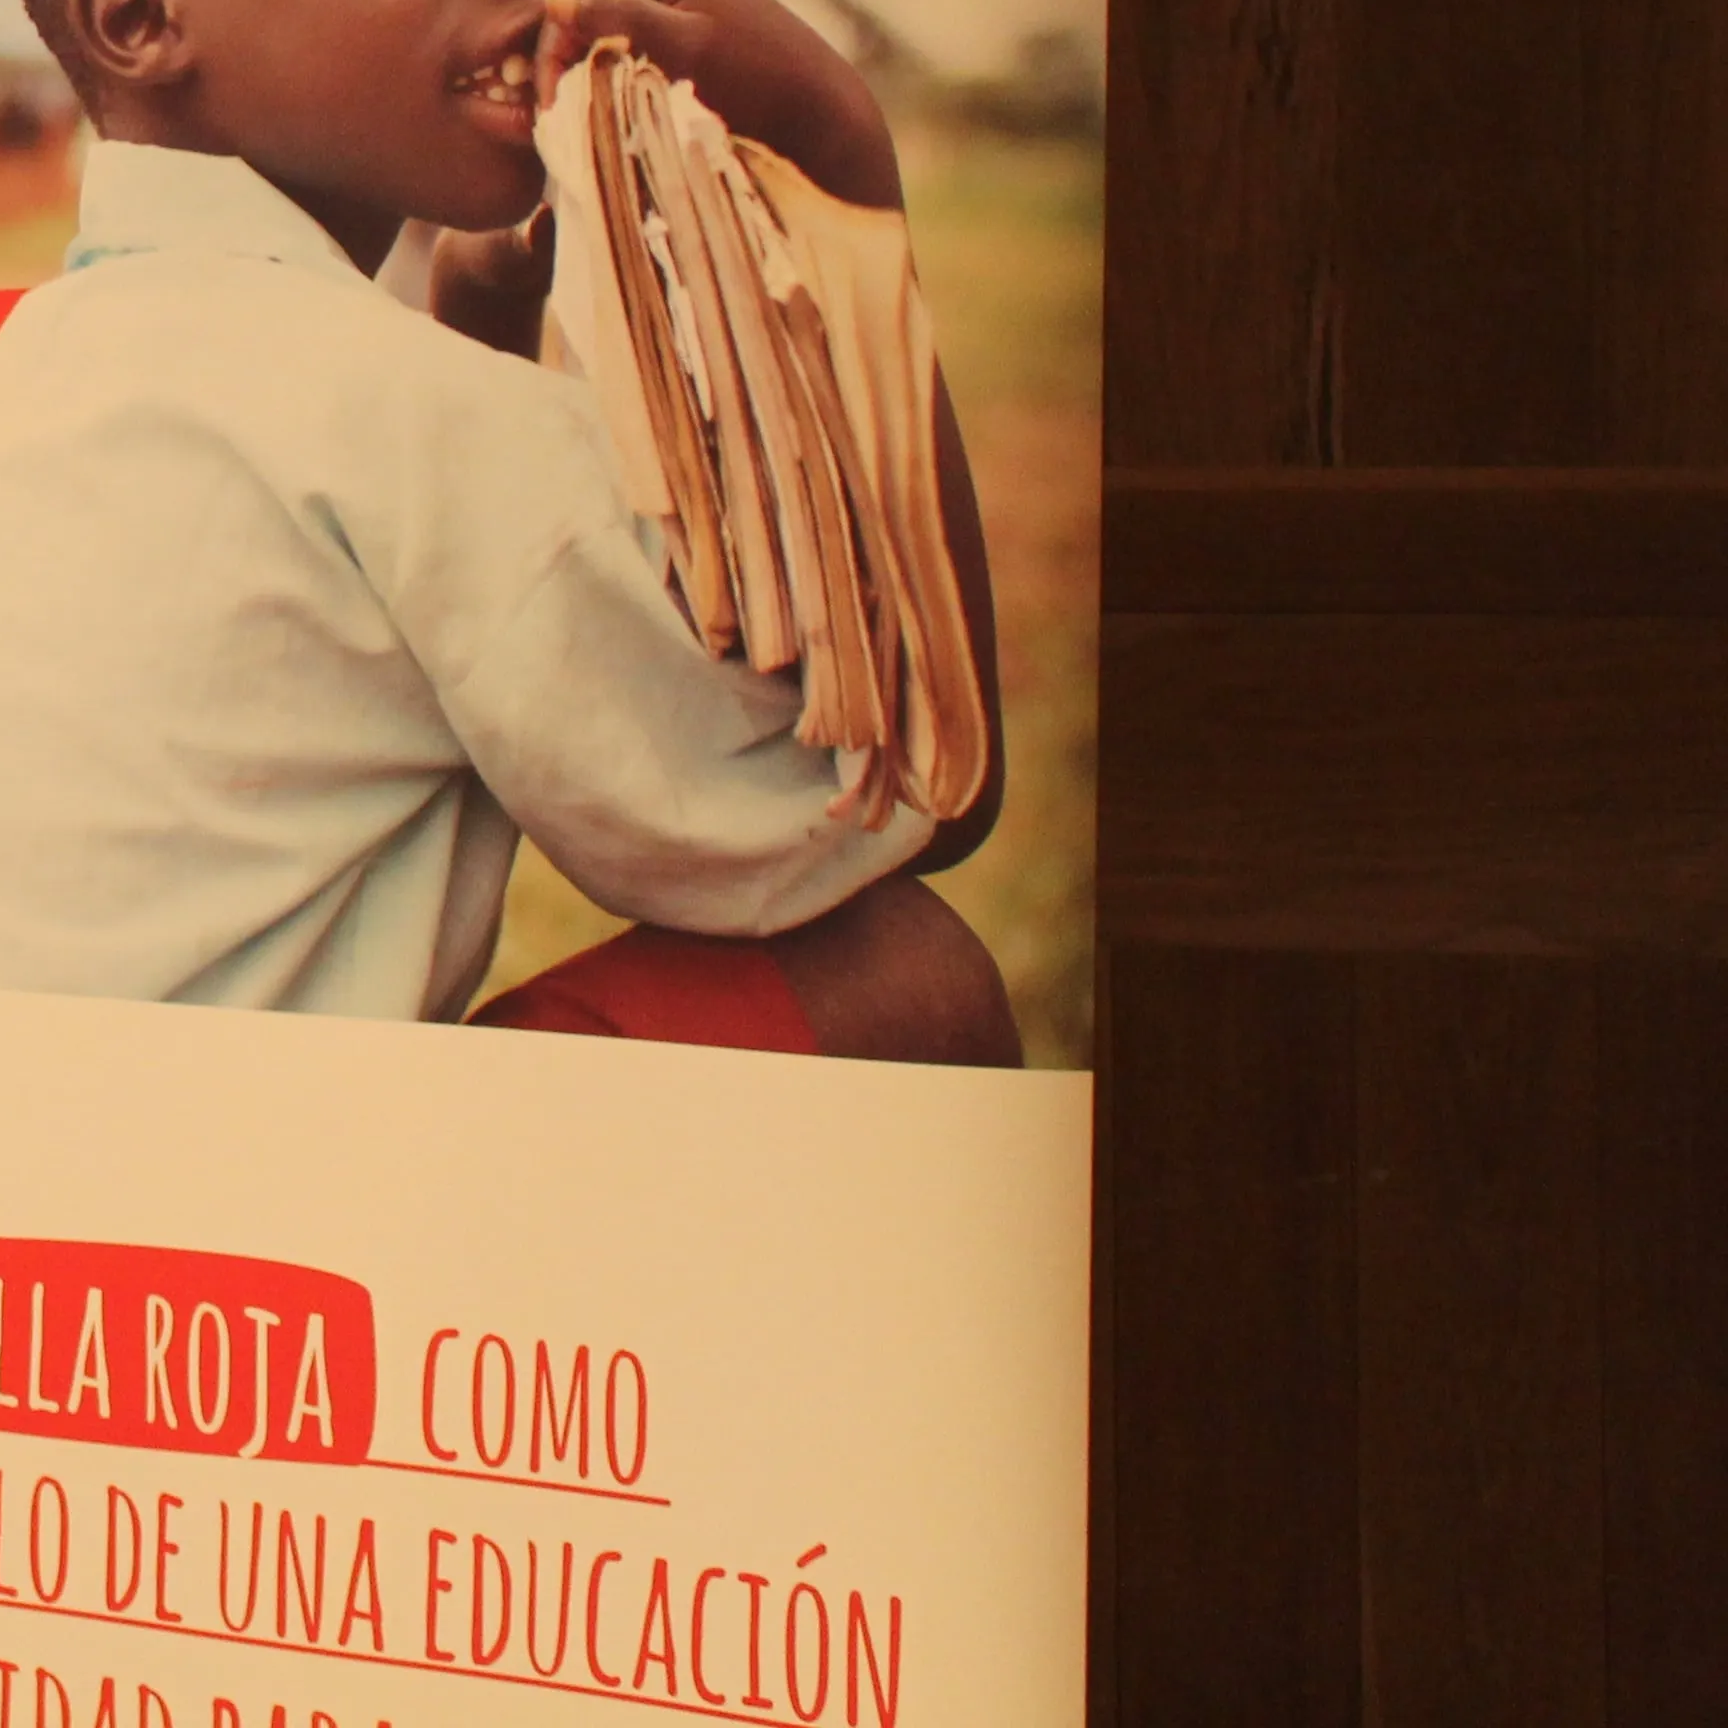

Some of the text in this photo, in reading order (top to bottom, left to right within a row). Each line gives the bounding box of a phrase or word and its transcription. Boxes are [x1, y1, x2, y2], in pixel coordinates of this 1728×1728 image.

[146, 1293, 334, 1459] ROJA
[420, 1327, 648, 1486] COMO
[105, 1484, 184, 1622] DE
[219, 1499, 385, 1652] UNA
[424, 1542, 903, 1728] EDUCACIÓN
